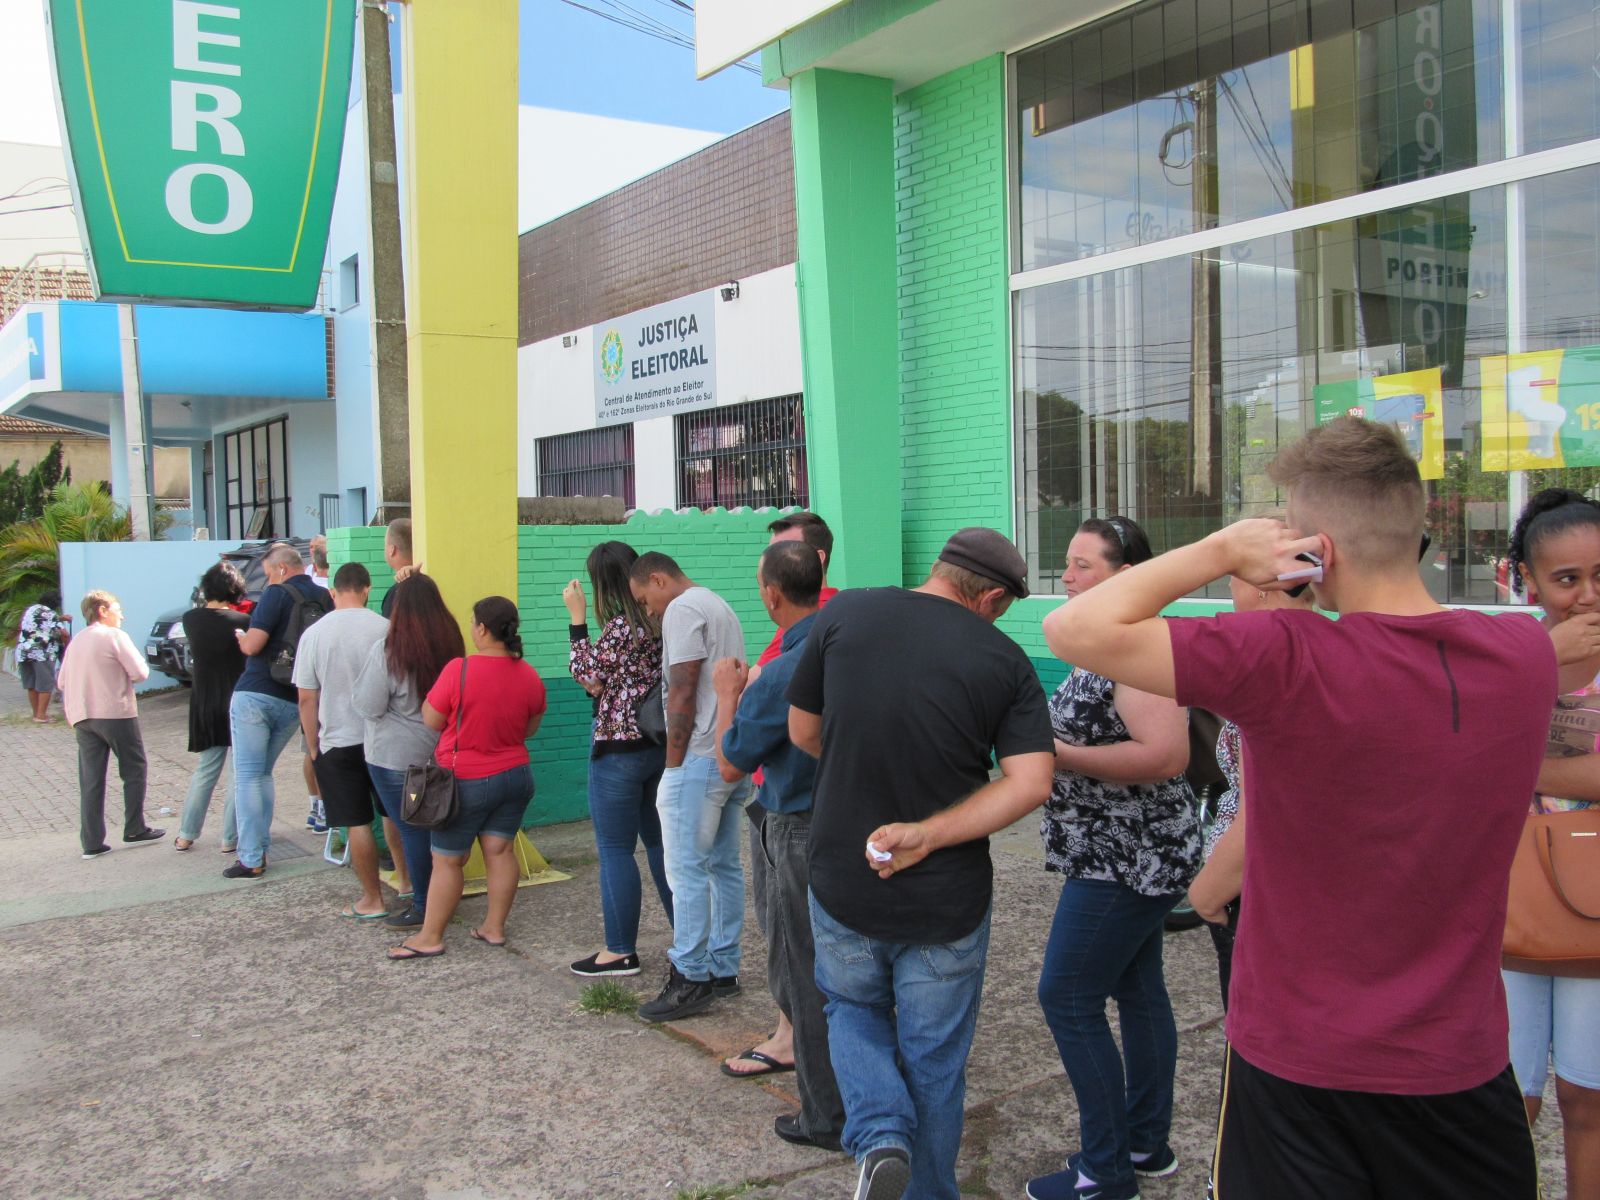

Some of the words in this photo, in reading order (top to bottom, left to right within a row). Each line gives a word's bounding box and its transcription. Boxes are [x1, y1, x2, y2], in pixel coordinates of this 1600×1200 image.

[638, 314, 698, 347] JUSTIÇA
[631, 344, 709, 380] ELEITORAL
[604, 394, 625, 407] Central
[625, 393, 633, 403] de
[634, 386, 672, 401] Atendimento
[673, 385, 681, 394] ao
[682, 379, 704, 392] Eleitor
[620, 407, 635, 416] Zonas
[635, 402, 659, 413] Eleitorais
[659, 401, 666, 409] do
[666, 399, 675, 408] Rio
[675, 395, 695, 406] Grande
[695, 393, 702, 402] do
[703, 391, 713, 401] Sul
